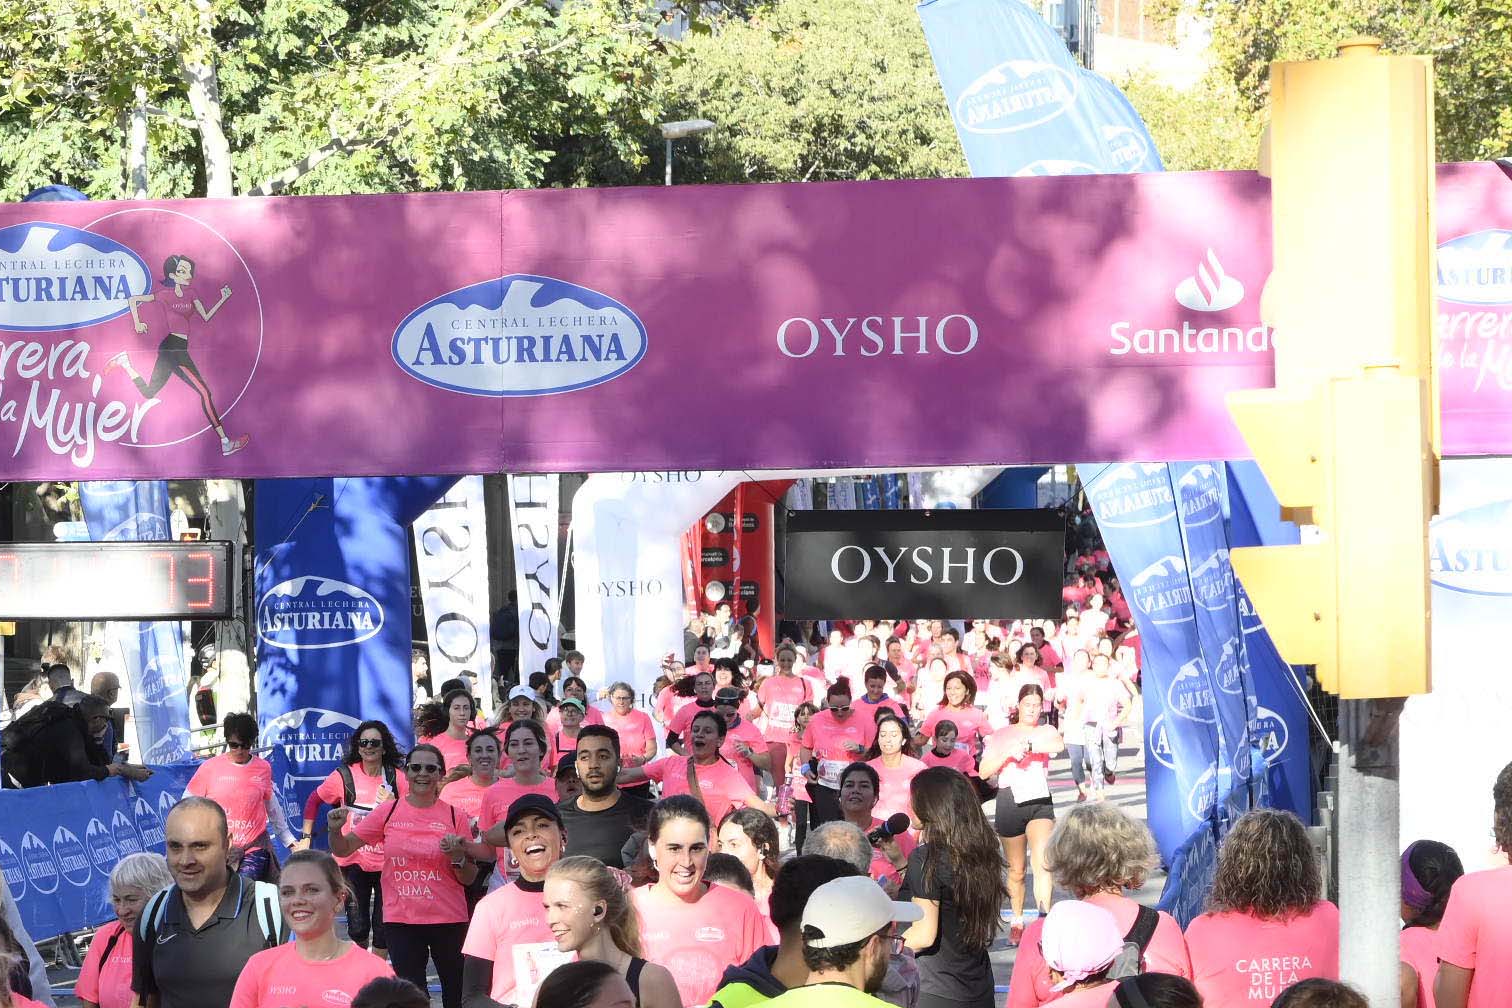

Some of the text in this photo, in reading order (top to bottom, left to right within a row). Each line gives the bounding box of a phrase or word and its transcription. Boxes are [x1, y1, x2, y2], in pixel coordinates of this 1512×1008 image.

[53, 258, 126, 270] LECHERA
[451, 315, 619, 329] CENTRAL LECHERA
[776, 313, 979, 358] OYSHO
[411, 321, 627, 366] ASTURIANA
[14, 377, 161, 468] Mujer
[831, 545, 1024, 585] OYSHO
[274, 600, 370, 609] CENTRAL LECHERA
[261, 606, 375, 633] ASTURIANA
[391, 857, 406, 867] TU
[394, 870, 442, 882] DORSAL
[398, 885, 432, 896] SUMA
[1236, 957, 1312, 973] CARRERA
[1251, 971, 1299, 985] DE LA
